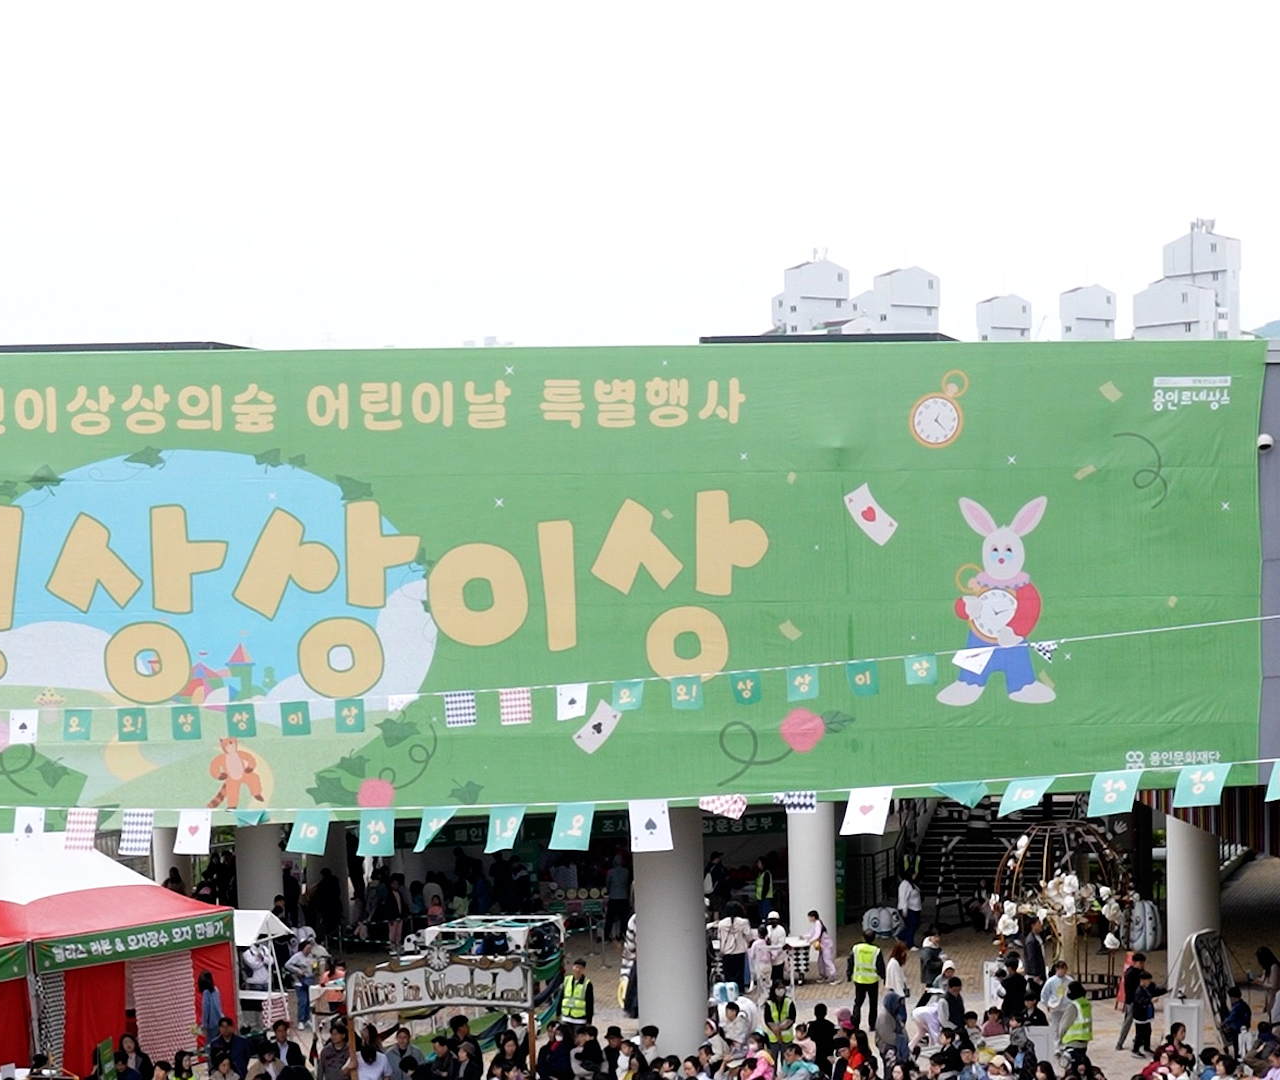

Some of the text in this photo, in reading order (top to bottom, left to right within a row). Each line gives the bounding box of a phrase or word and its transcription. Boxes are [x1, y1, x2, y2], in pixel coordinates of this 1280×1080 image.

[307, 380, 511, 430] 어린이날
[540, 377, 746, 429] 특별행사
[736, 678, 755, 699] 상
[793, 673, 813, 694] 상
[911, 659, 931, 678] 상
[177, 712, 196, 734] 상
[231, 710, 251, 731] 상
[341, 705, 359, 727] 상
[1149, 750, 1222, 766] 용인문화재단
[114, 937, 126, 953] &
[172, 926, 193, 943] 모자
[195, 920, 225, 940] 만들기
